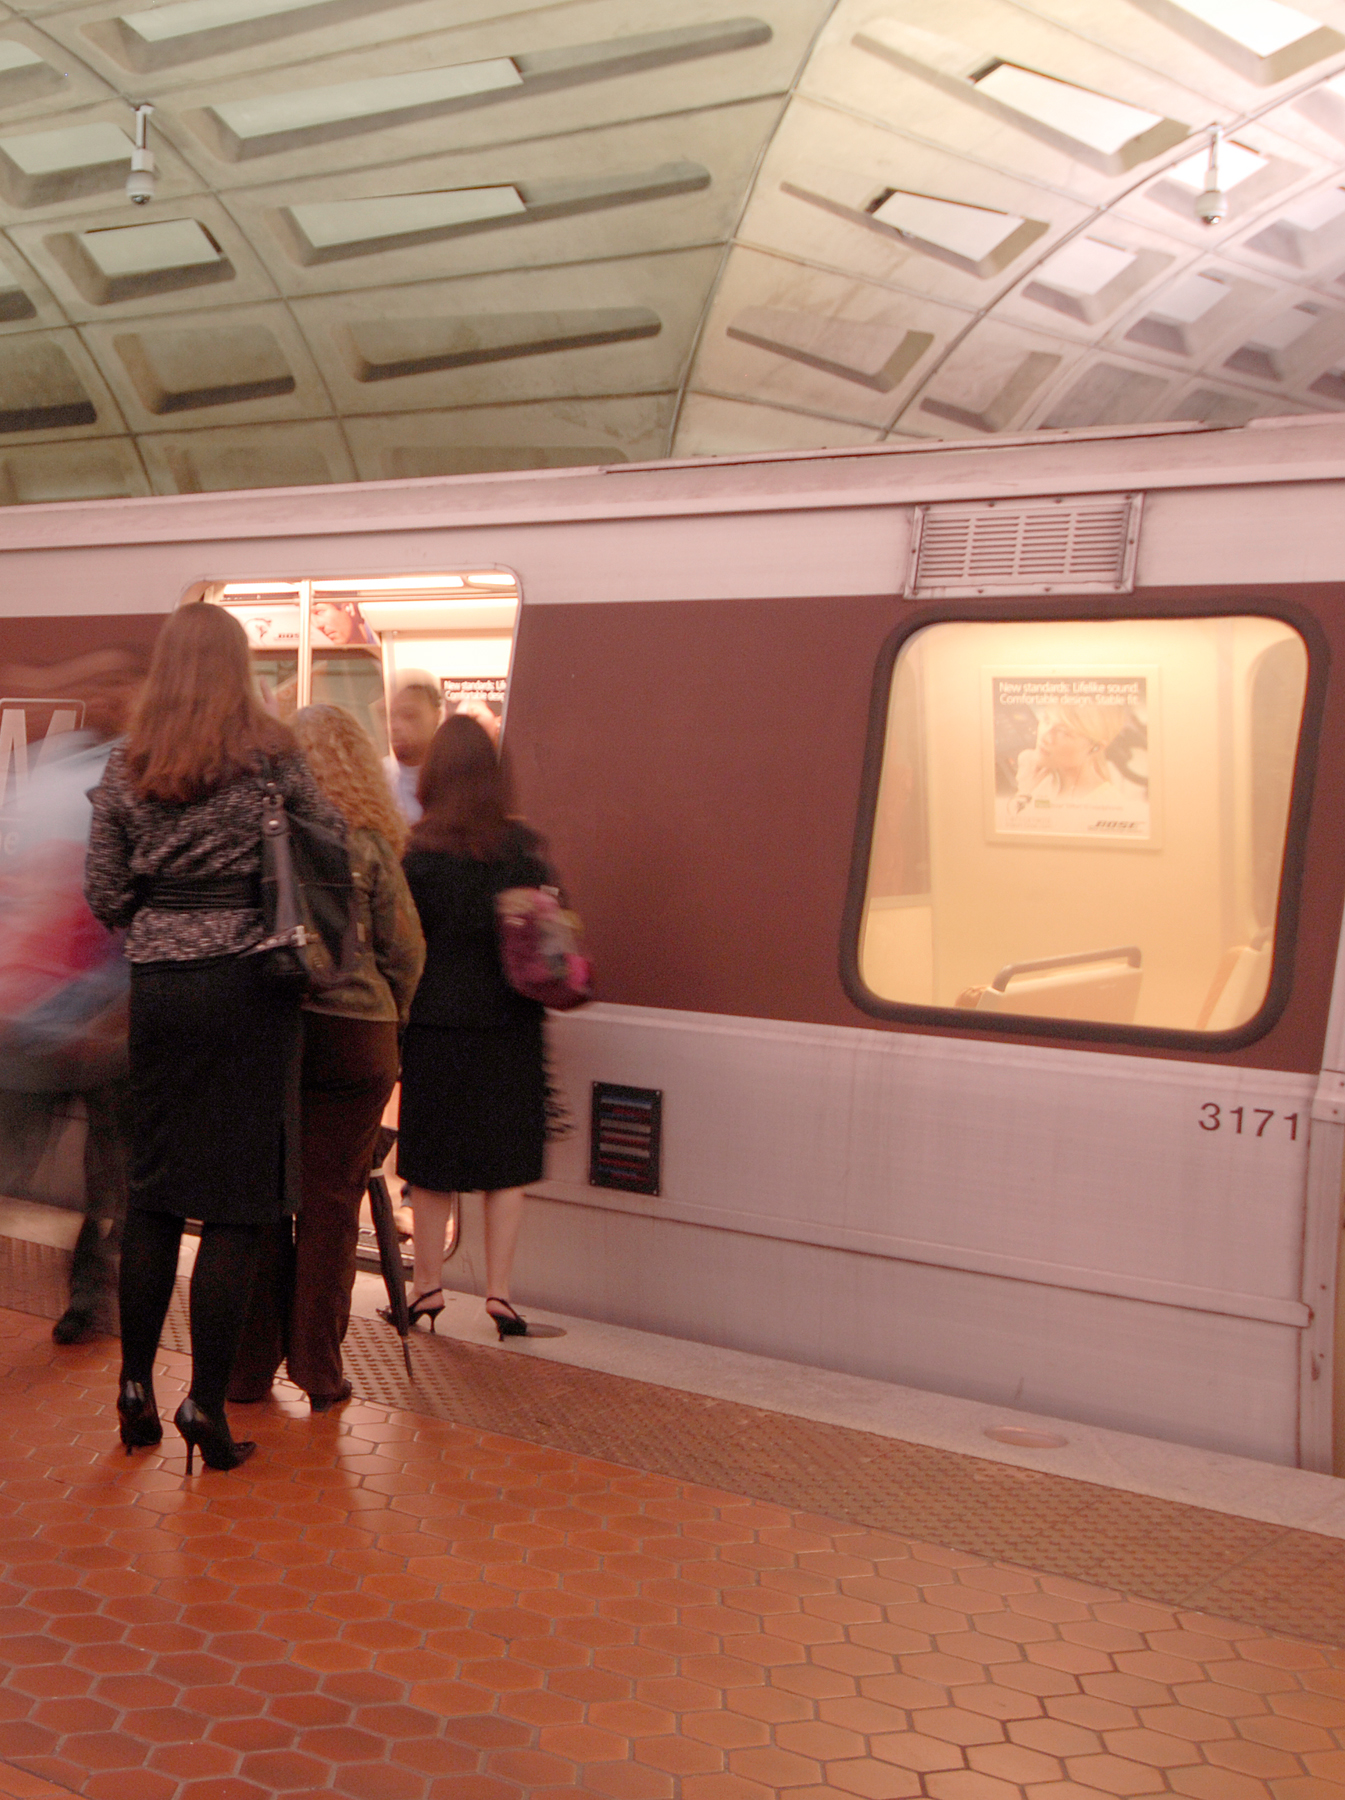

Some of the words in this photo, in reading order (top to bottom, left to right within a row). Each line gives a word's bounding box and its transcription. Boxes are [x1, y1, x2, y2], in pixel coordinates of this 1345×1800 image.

[444, 680, 460, 690] New
[999, 681, 1023, 693] New
[1073, 681, 1106, 693] Lifelike
[1000, 693, 1059, 705] Comfortable
[1095, 694, 1126, 705] Stable
[1095, 820, 1146, 829] BOSE
[1198, 1102, 1298, 1141] 3171
